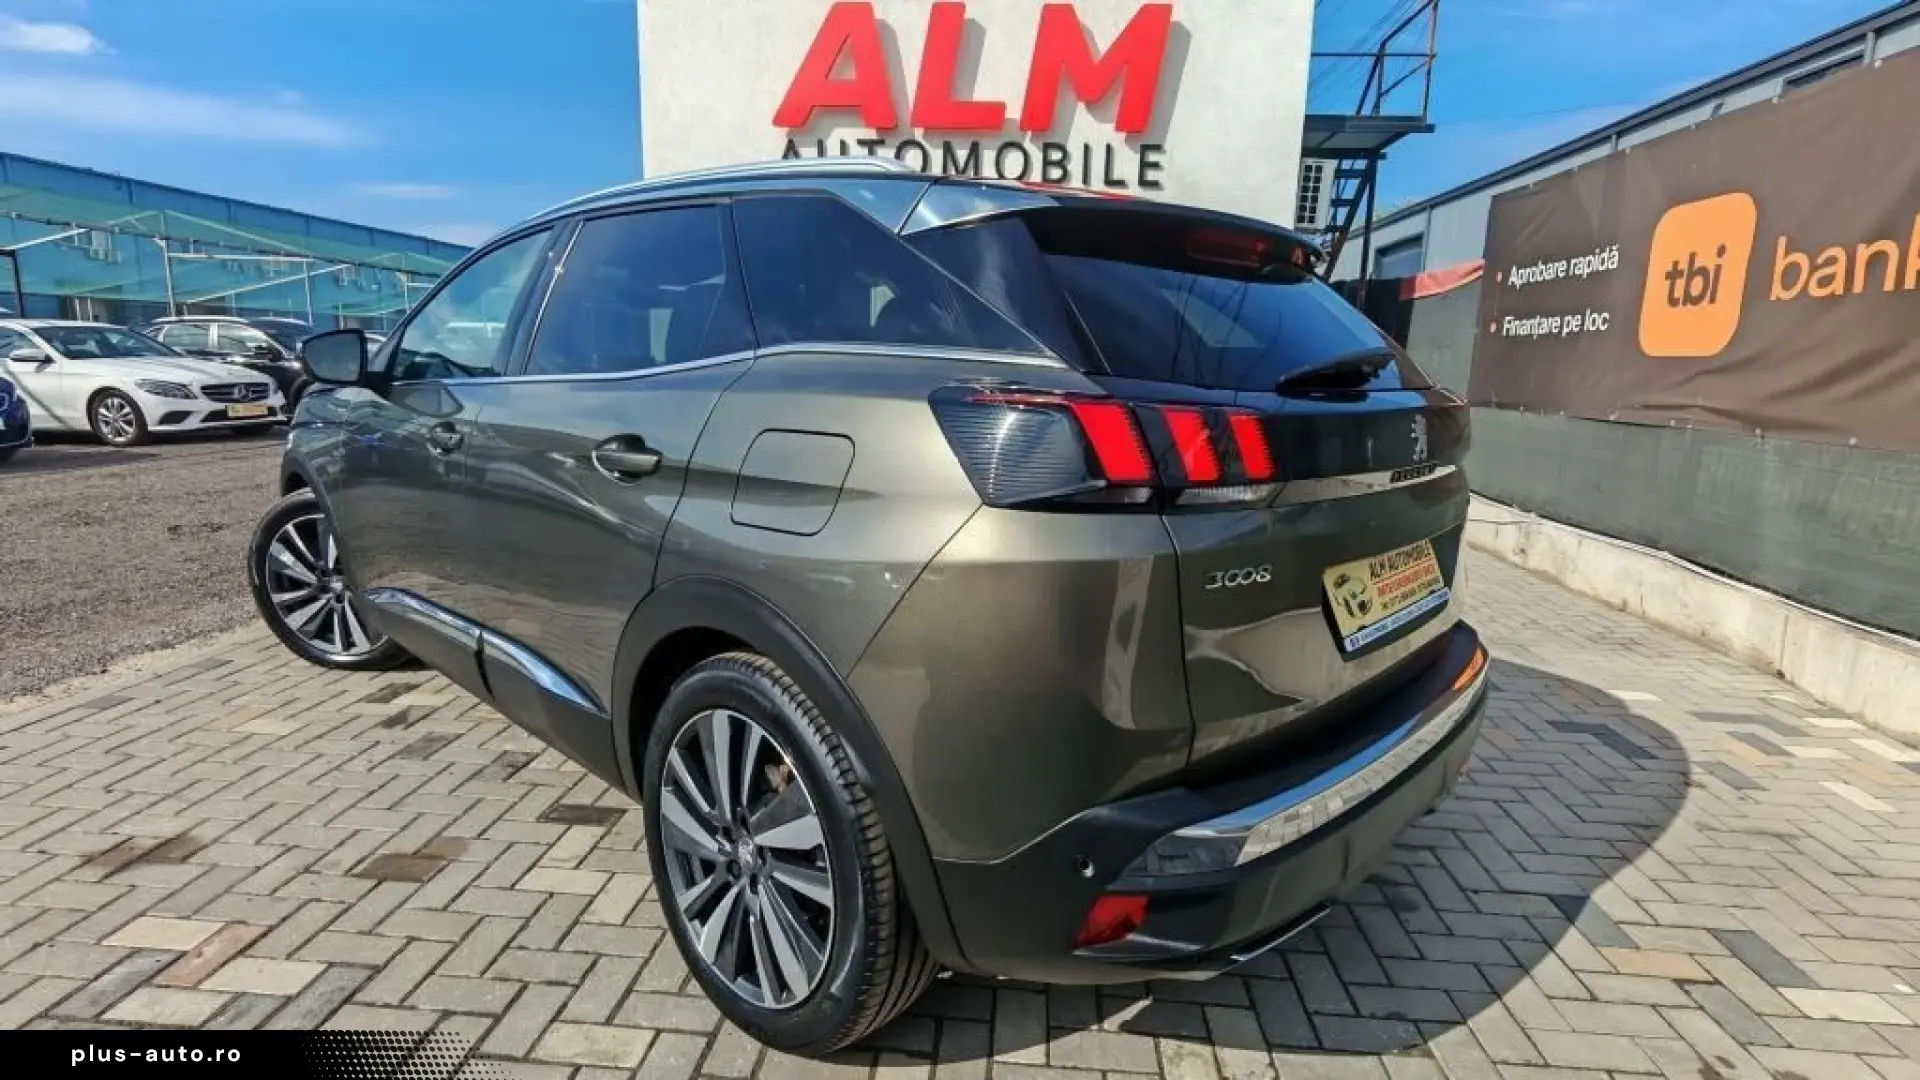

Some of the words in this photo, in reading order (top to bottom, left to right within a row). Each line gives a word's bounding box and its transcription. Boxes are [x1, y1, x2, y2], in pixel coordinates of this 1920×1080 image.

[772, 1, 1173, 133] ALM
[1508, 260, 1567, 290] Aprobare
[1665, 244, 1726, 307] tbi
[1562, 314, 1582, 337] pe
[1583, 307, 1609, 331] loc
[1204, 563, 1273, 590] 3008
